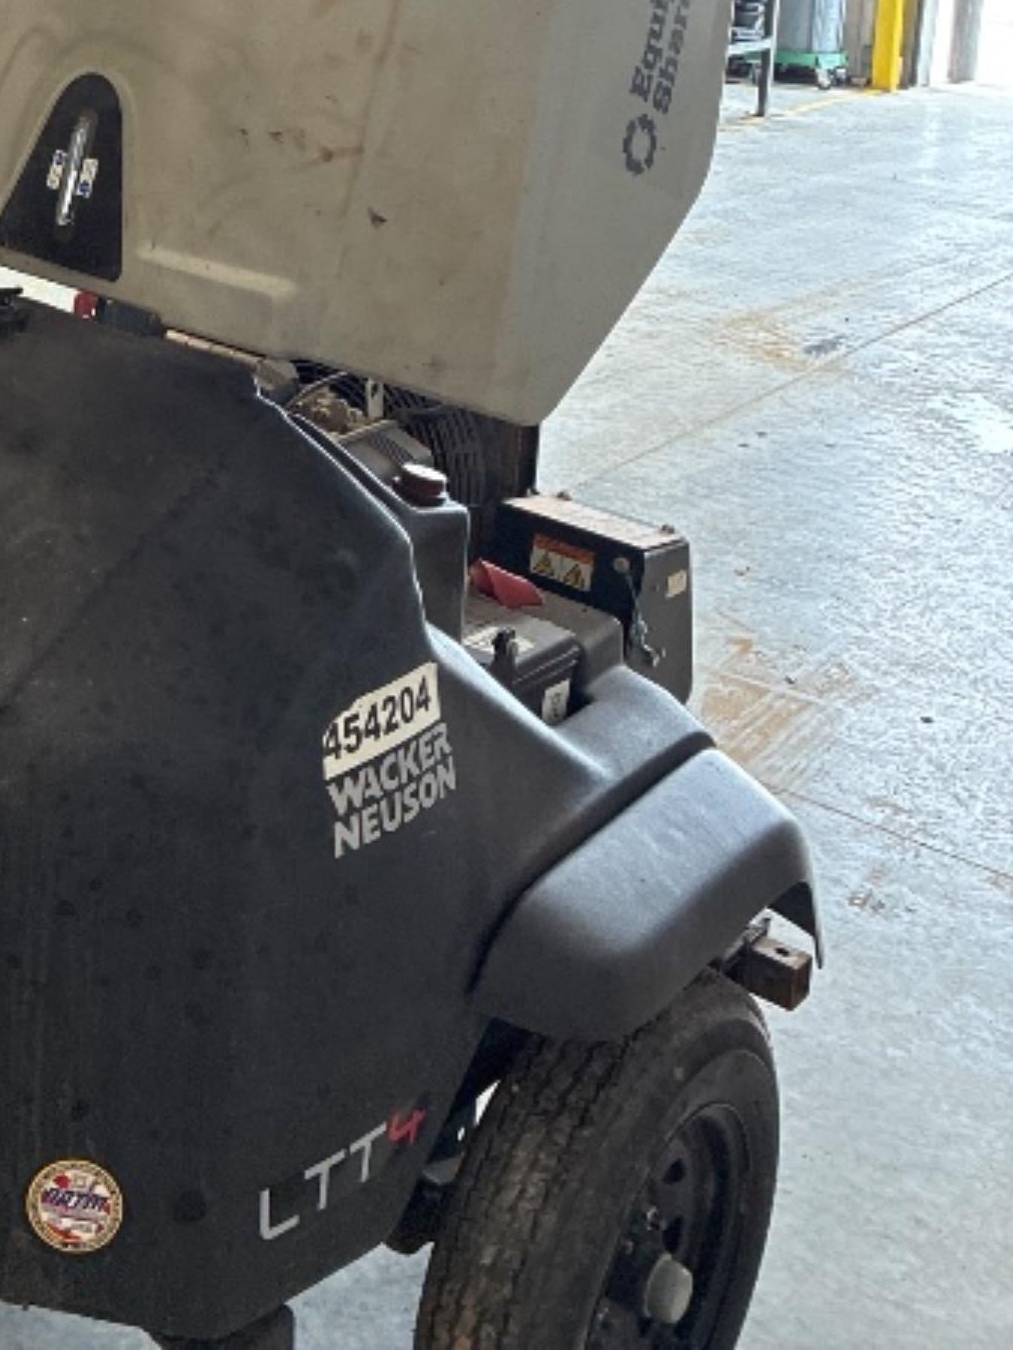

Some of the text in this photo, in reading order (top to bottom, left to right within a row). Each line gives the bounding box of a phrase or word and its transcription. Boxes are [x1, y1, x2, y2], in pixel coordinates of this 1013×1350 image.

[323, 673, 431, 760] 454204
[326, 722, 453, 816] WACKER
[333, 755, 456, 859] NEUSON
[259, 1108, 427, 1241] LTT4
